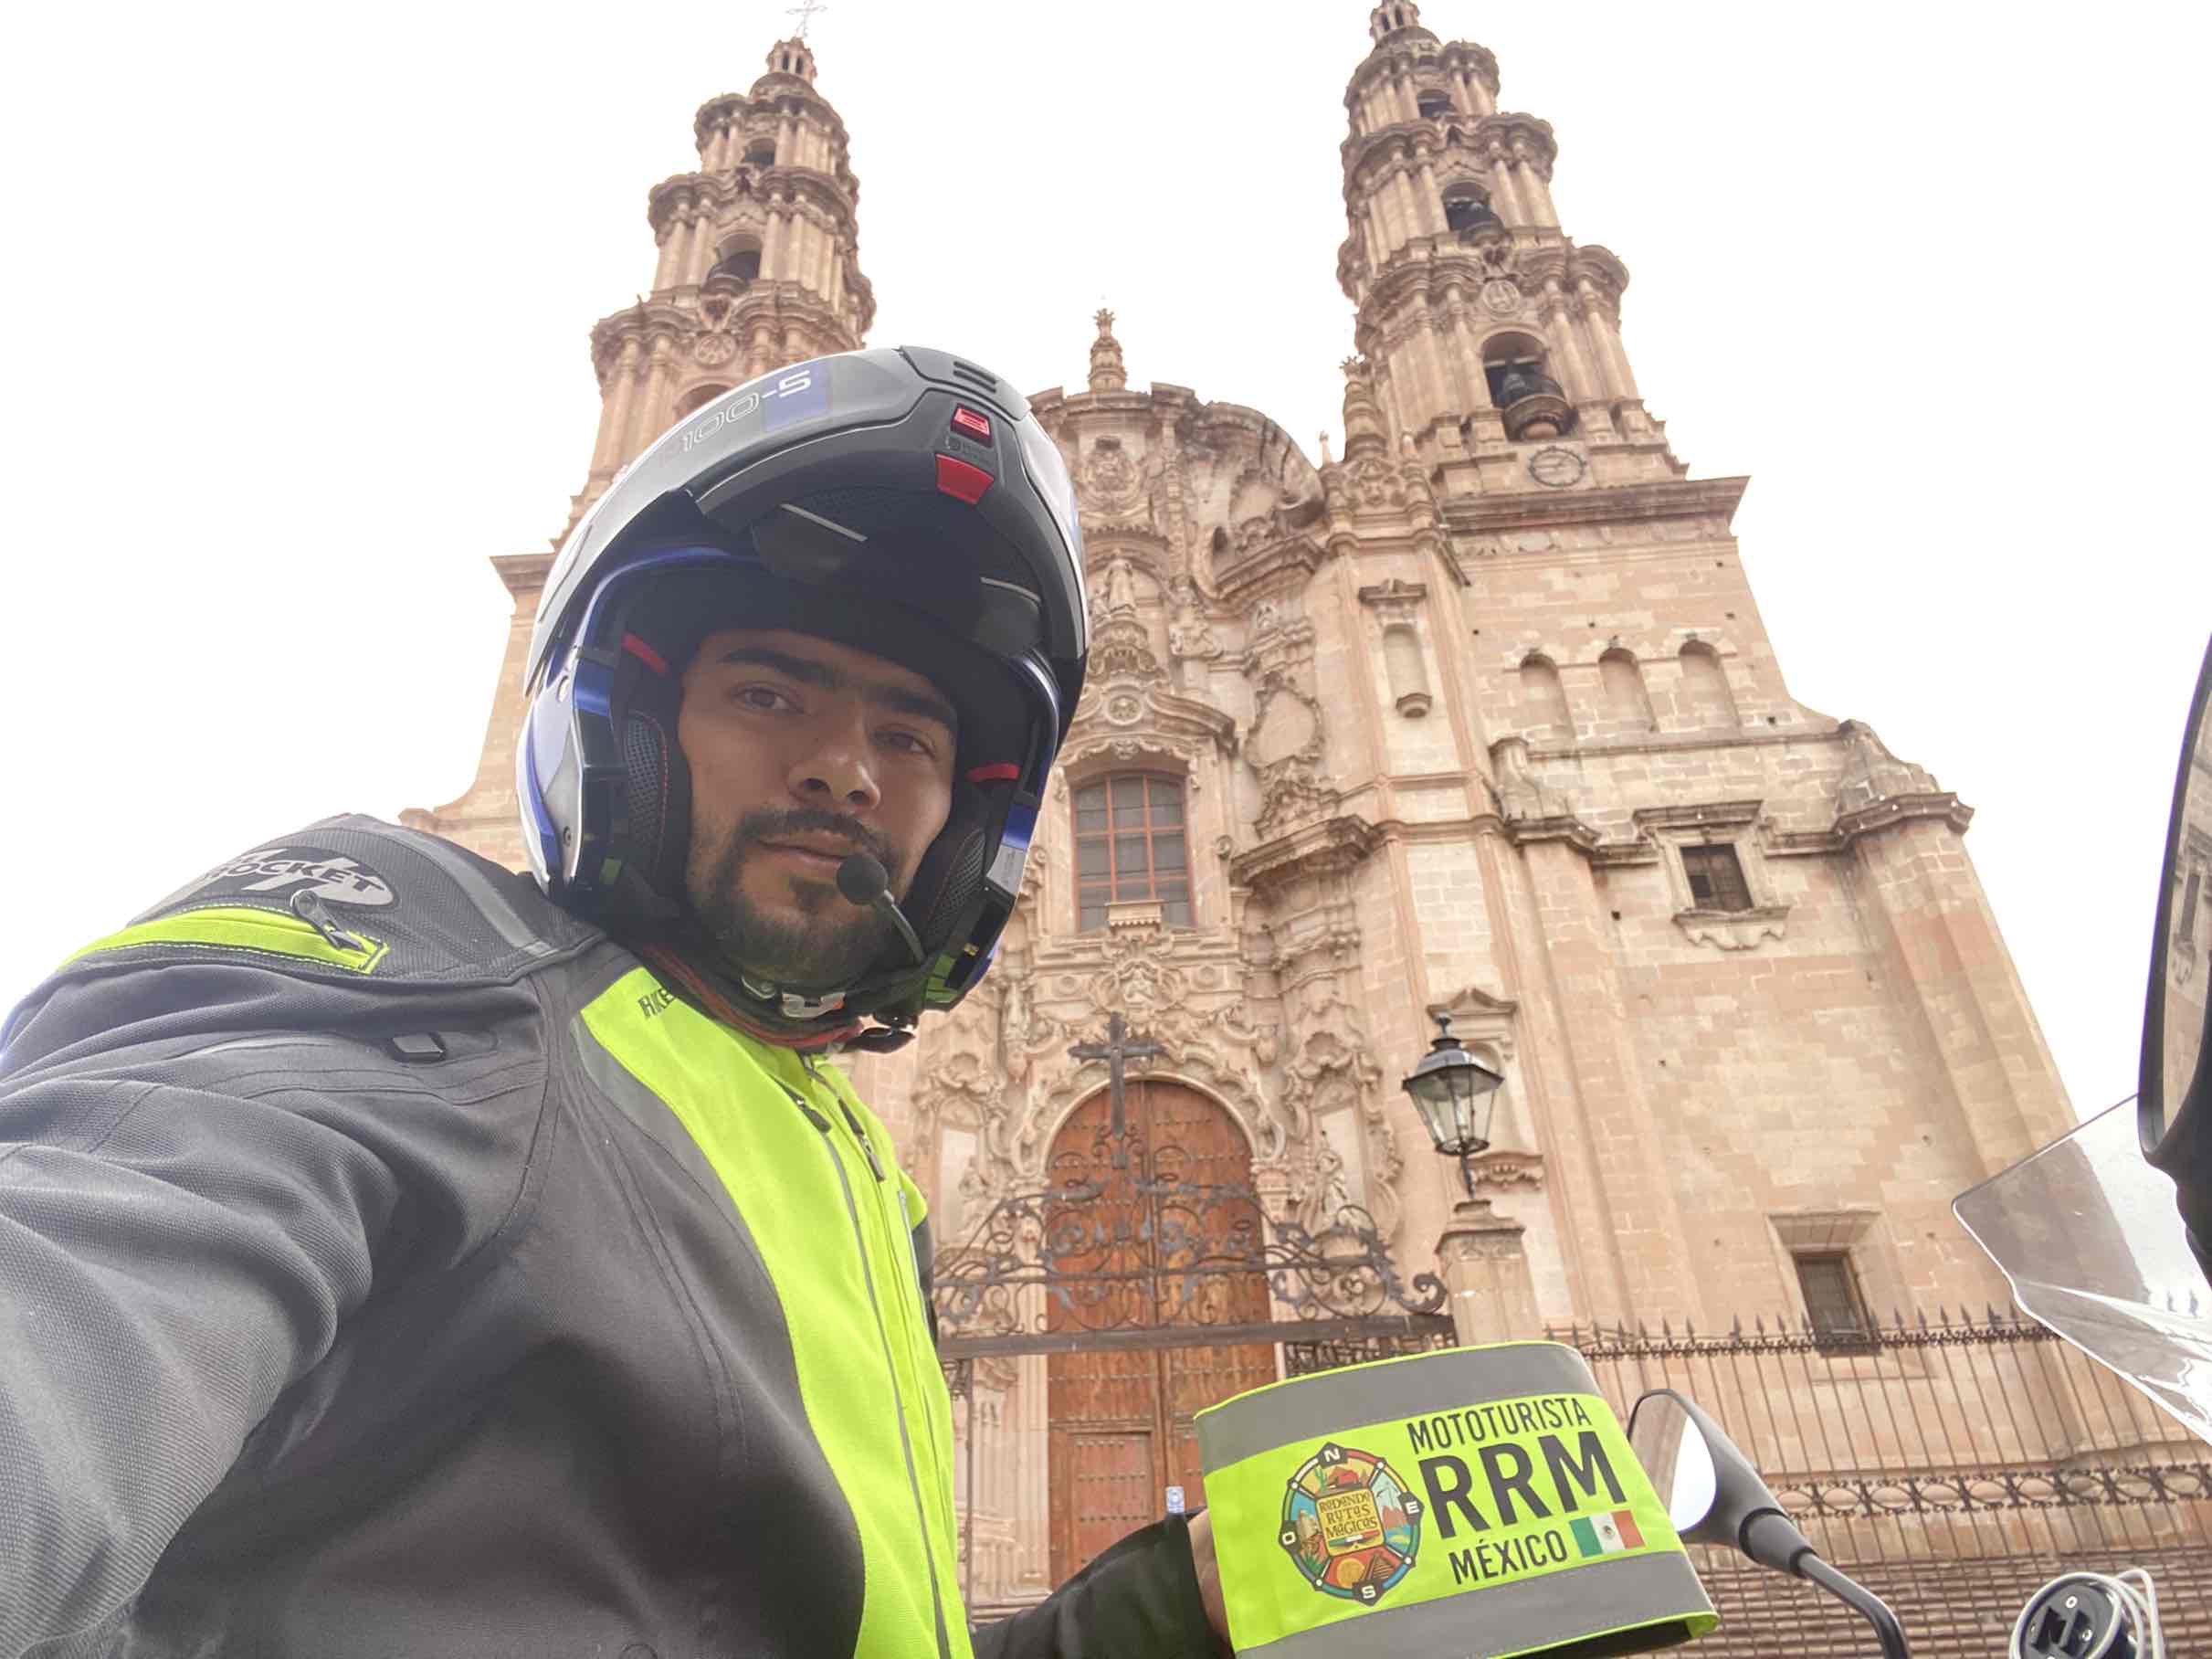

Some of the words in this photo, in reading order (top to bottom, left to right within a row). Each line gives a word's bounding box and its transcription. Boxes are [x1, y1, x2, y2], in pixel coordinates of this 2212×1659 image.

[1406, 1398, 1593, 1455] MOTOTURISTA
[1324, 1448, 1341, 1463] N
[1418, 1431, 1627, 1539] RRM
[1405, 1500, 1420, 1516] E
[1281, 1531, 1297, 1546] O
[1448, 1529, 1568, 1585] MÉXICO
[1361, 1585, 1376, 1600] S
